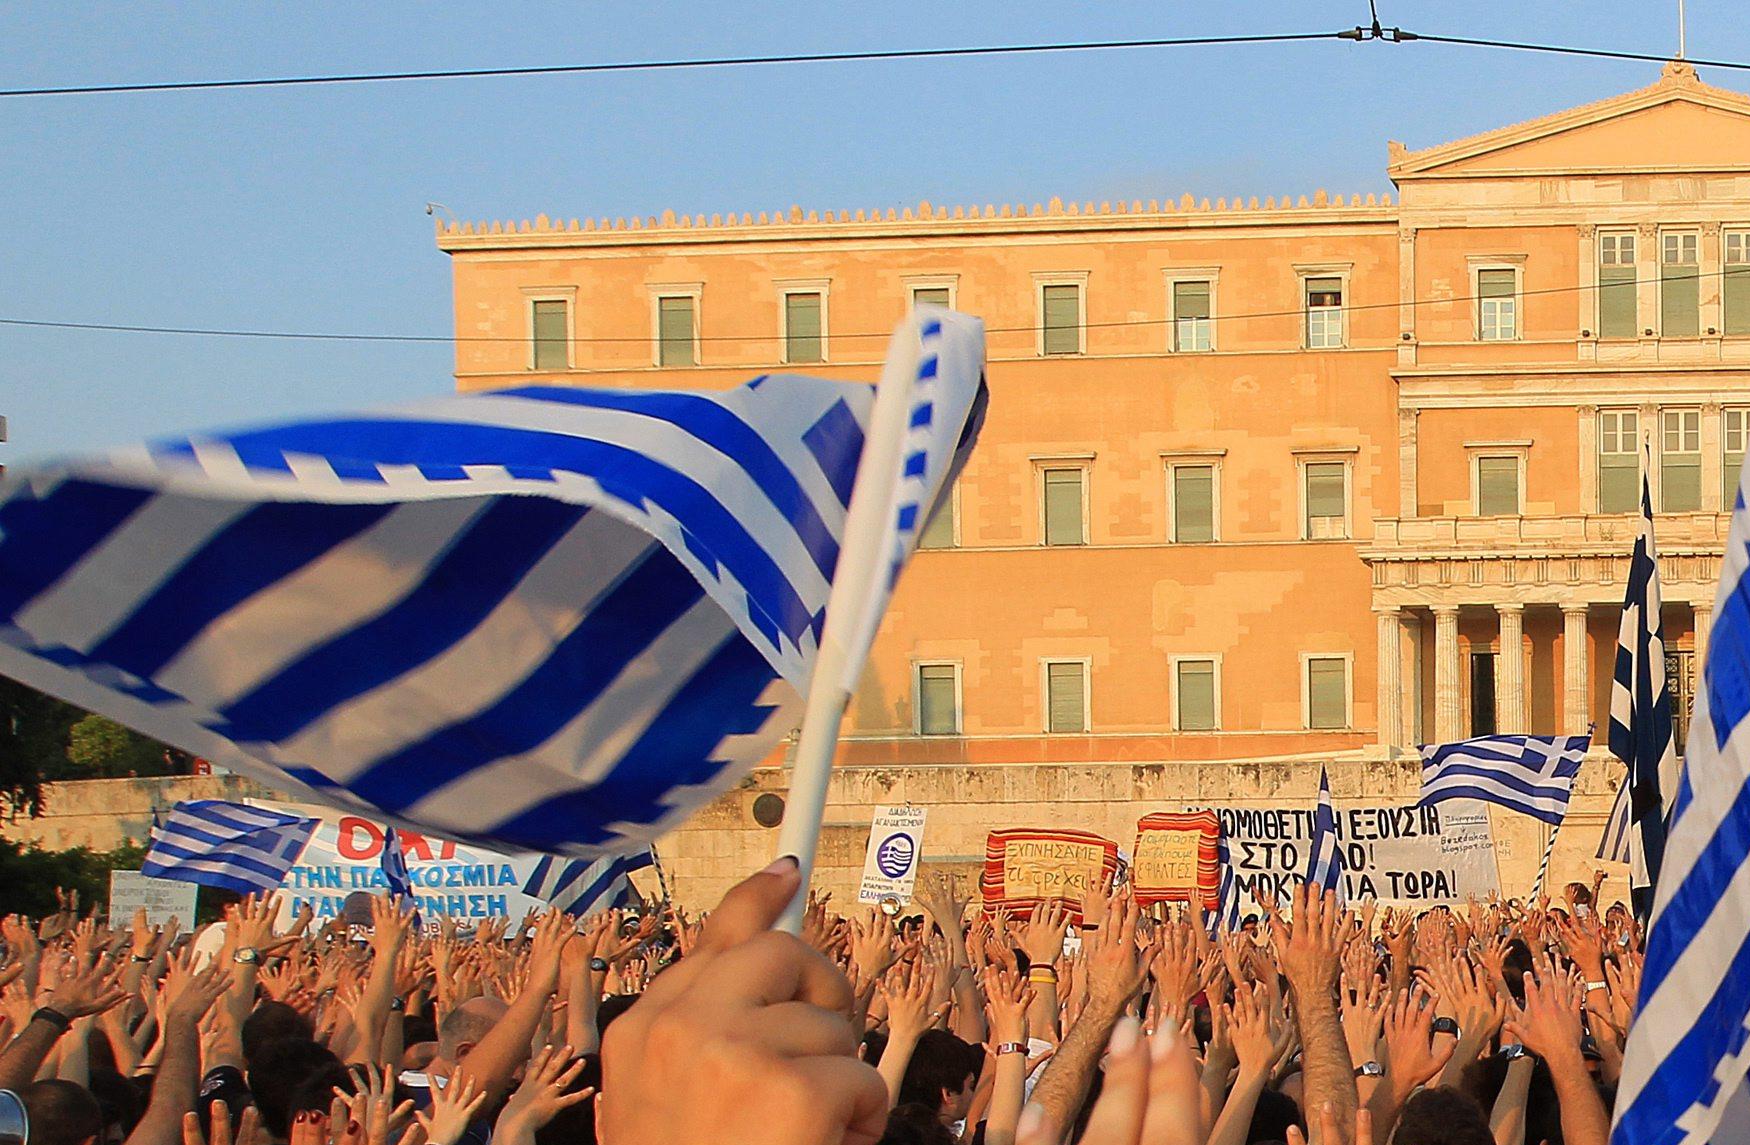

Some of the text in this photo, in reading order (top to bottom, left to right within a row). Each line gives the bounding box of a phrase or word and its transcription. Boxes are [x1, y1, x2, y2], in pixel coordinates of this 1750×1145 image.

[1207, 807, 1343, 841] ΟΜΟΘΕΤΙΗ
[1007, 843, 1098, 862] ΞΥΠΝΗΣΑΜΕ
[1239, 842, 1299, 871] ΣΤΟ
[350, 864, 519, 889] ΠΑΚΟΣΜΙΑ
